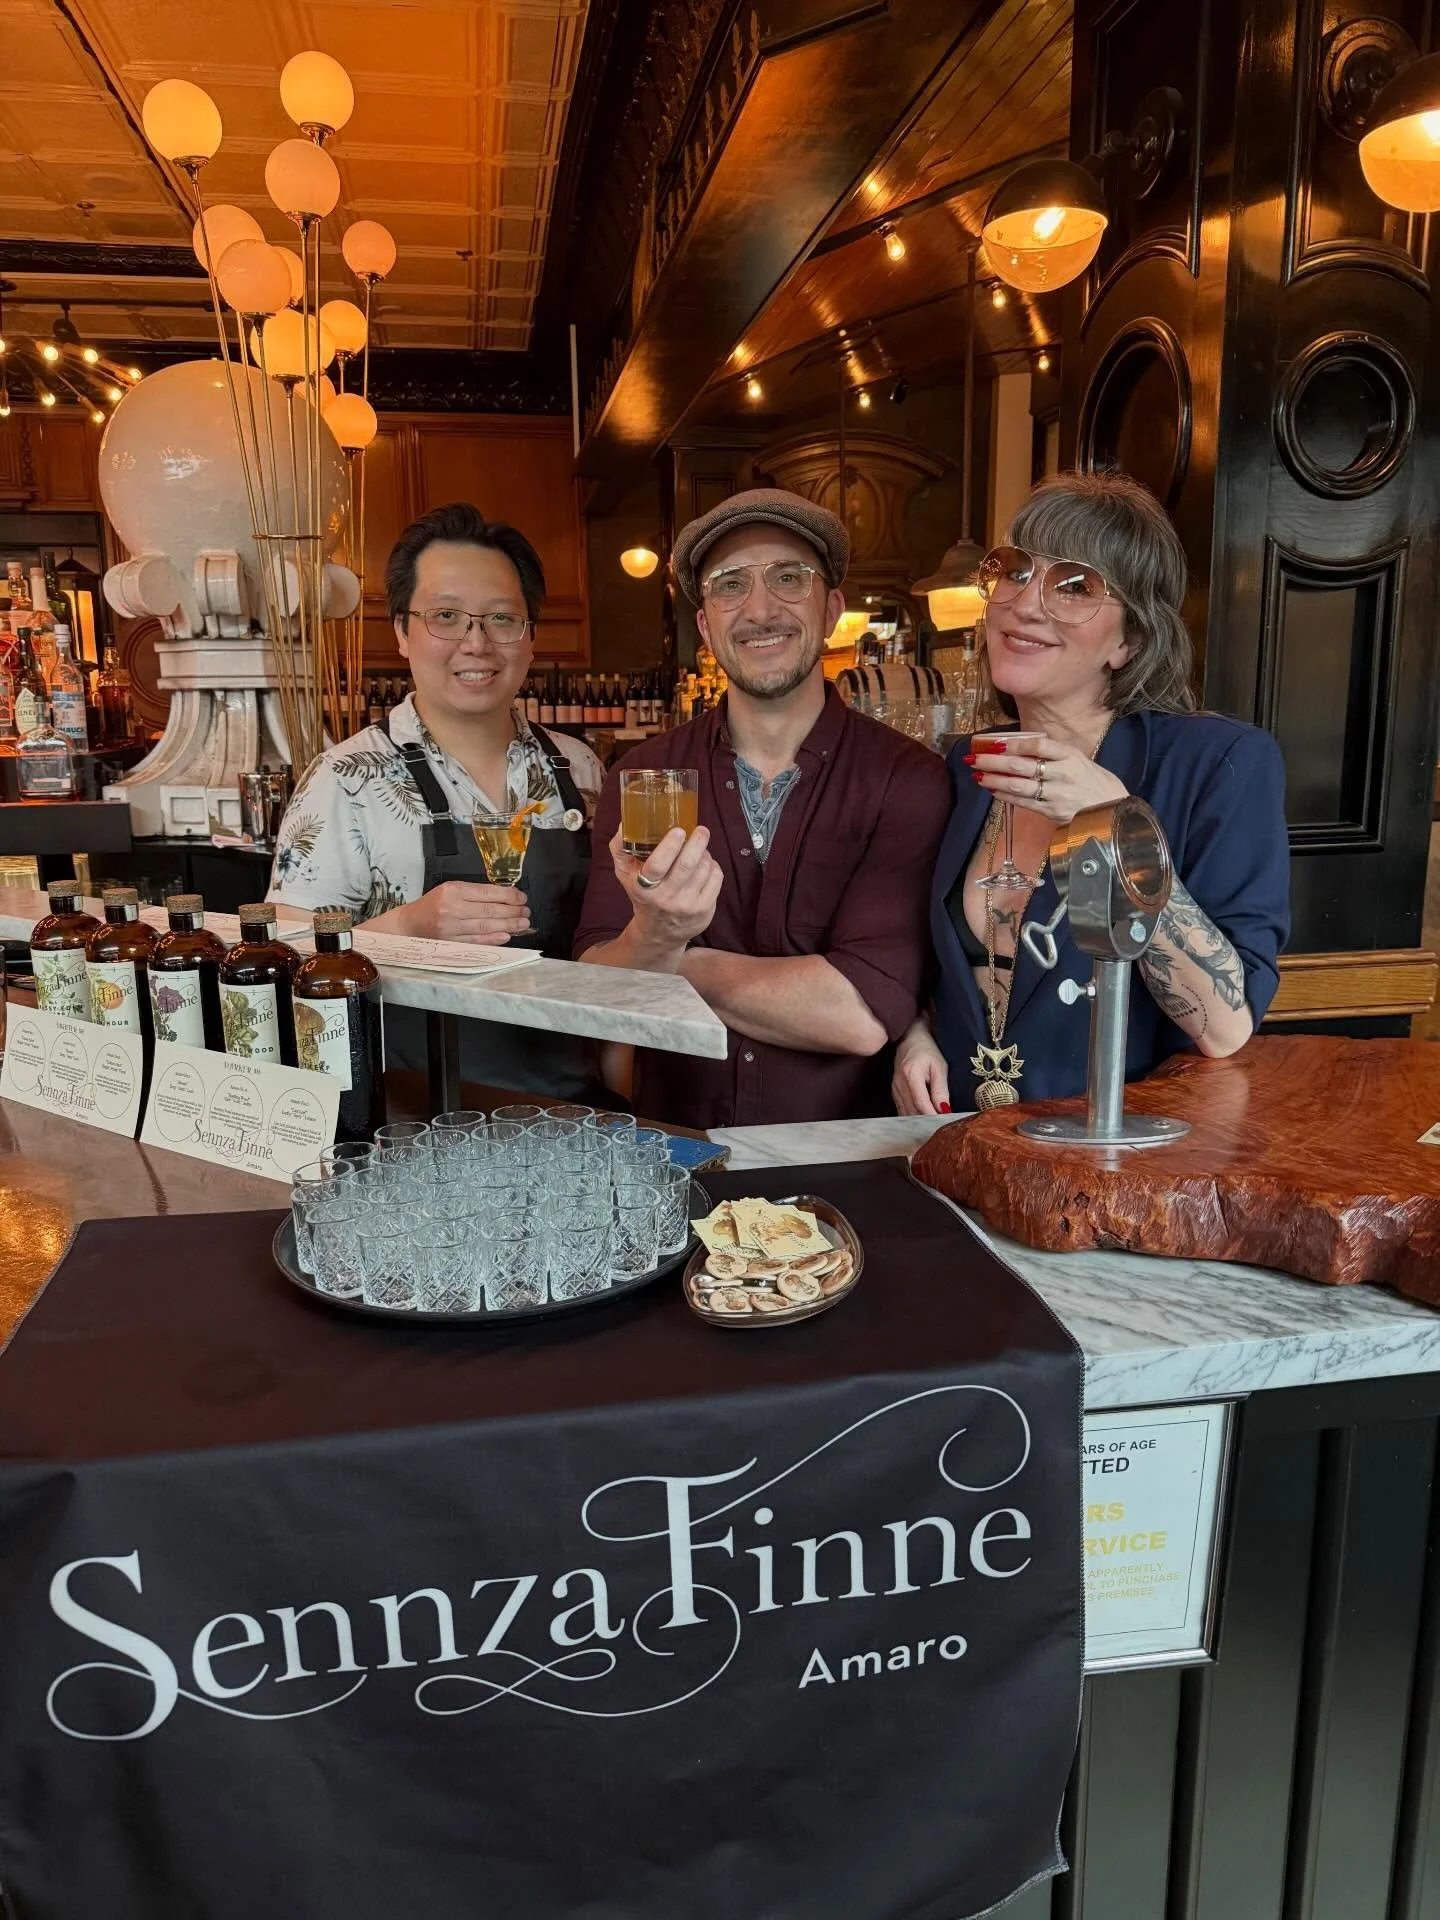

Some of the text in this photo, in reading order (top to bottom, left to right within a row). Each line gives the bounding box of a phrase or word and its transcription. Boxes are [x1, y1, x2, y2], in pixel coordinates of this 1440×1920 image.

[191, 1118, 236, 1151] Sennza
[236, 1129, 273, 1160] Finne
[1108, 1441, 1127, 1453] OF
[1129, 1439, 1157, 1451] AGE
[47, 1385, 1033, 1741] Sennza Finne
[798, 1634, 968, 1689] Amaro
